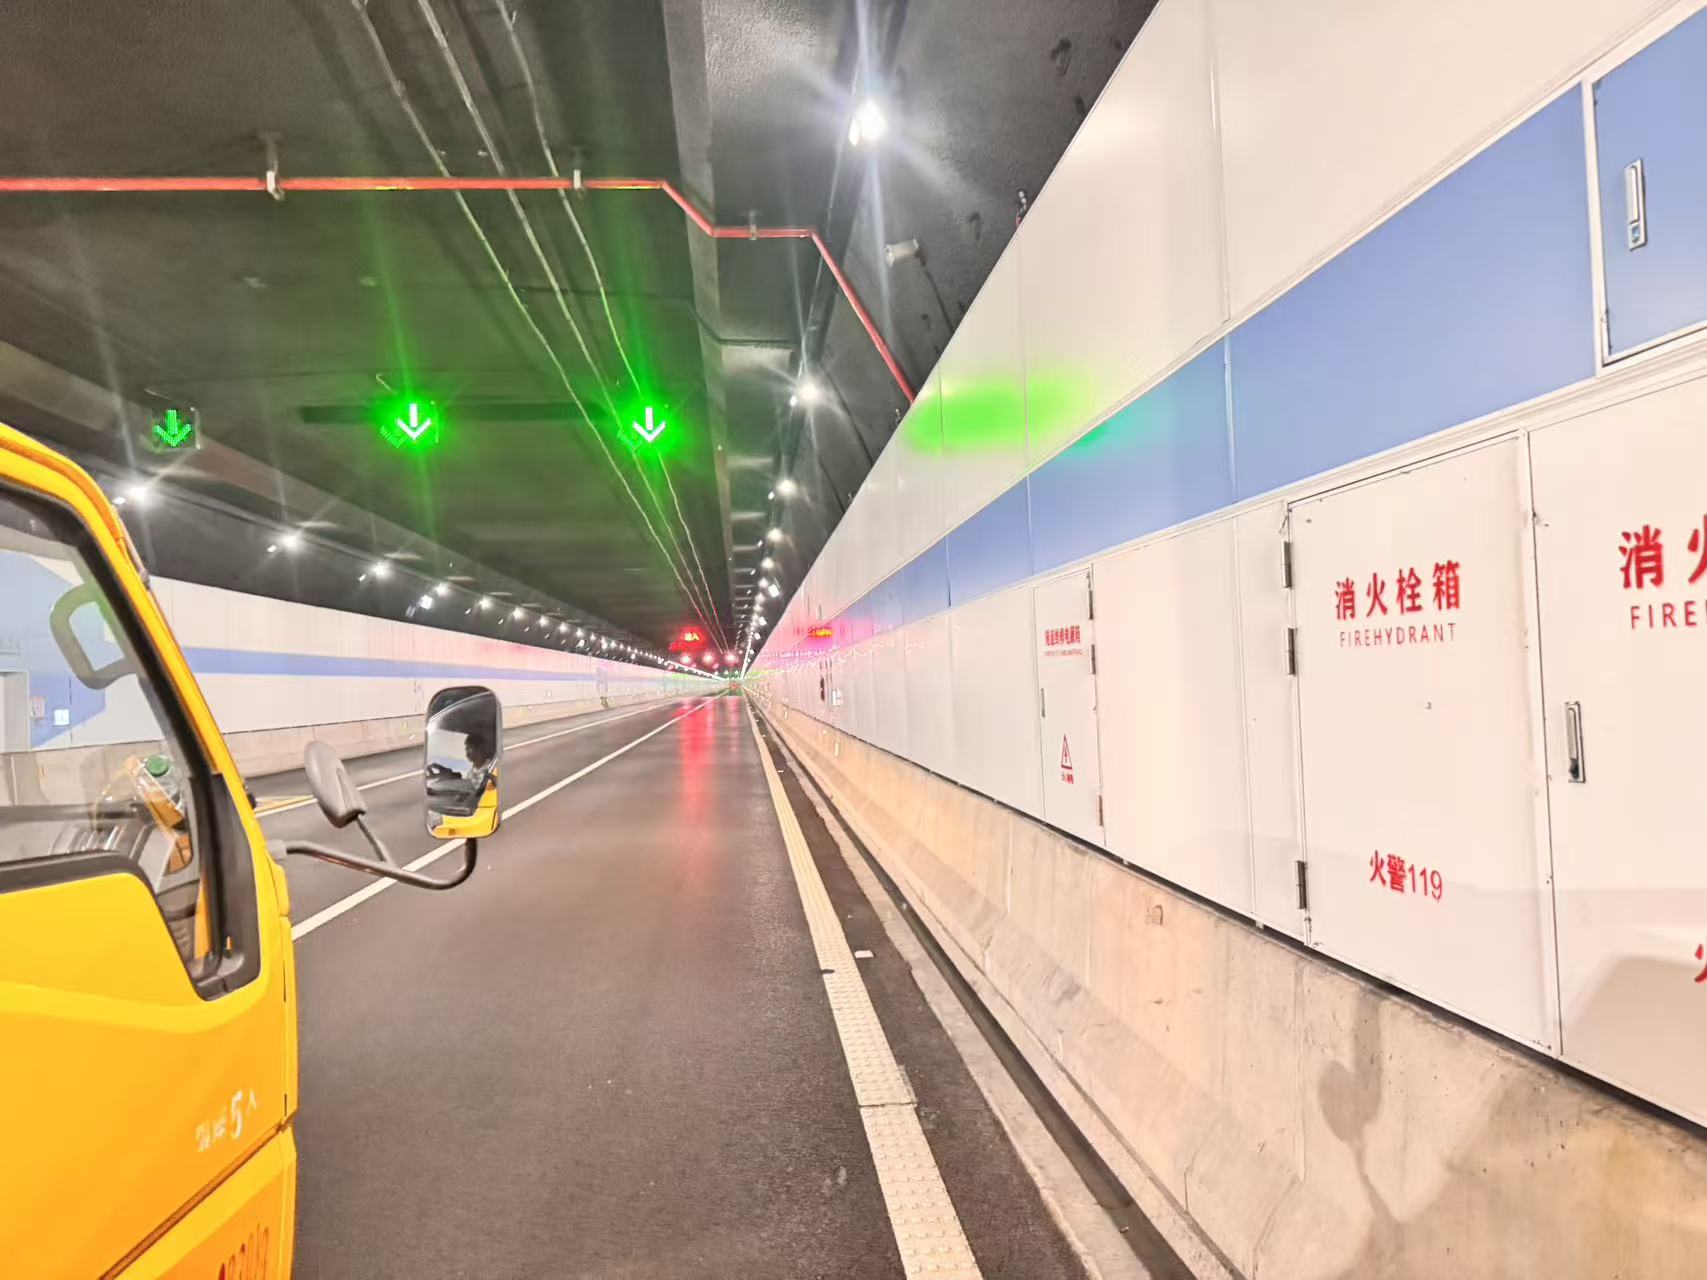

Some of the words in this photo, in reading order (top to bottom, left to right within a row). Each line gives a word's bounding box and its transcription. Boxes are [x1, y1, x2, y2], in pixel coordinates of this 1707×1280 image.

[1335, 560, 1461, 620] 消火栓箱
[1340, 622, 1456, 647] FIREHYDRANT
[1630, 599, 1707, 629] FIRE
[1370, 849, 1442, 903] 火警119
